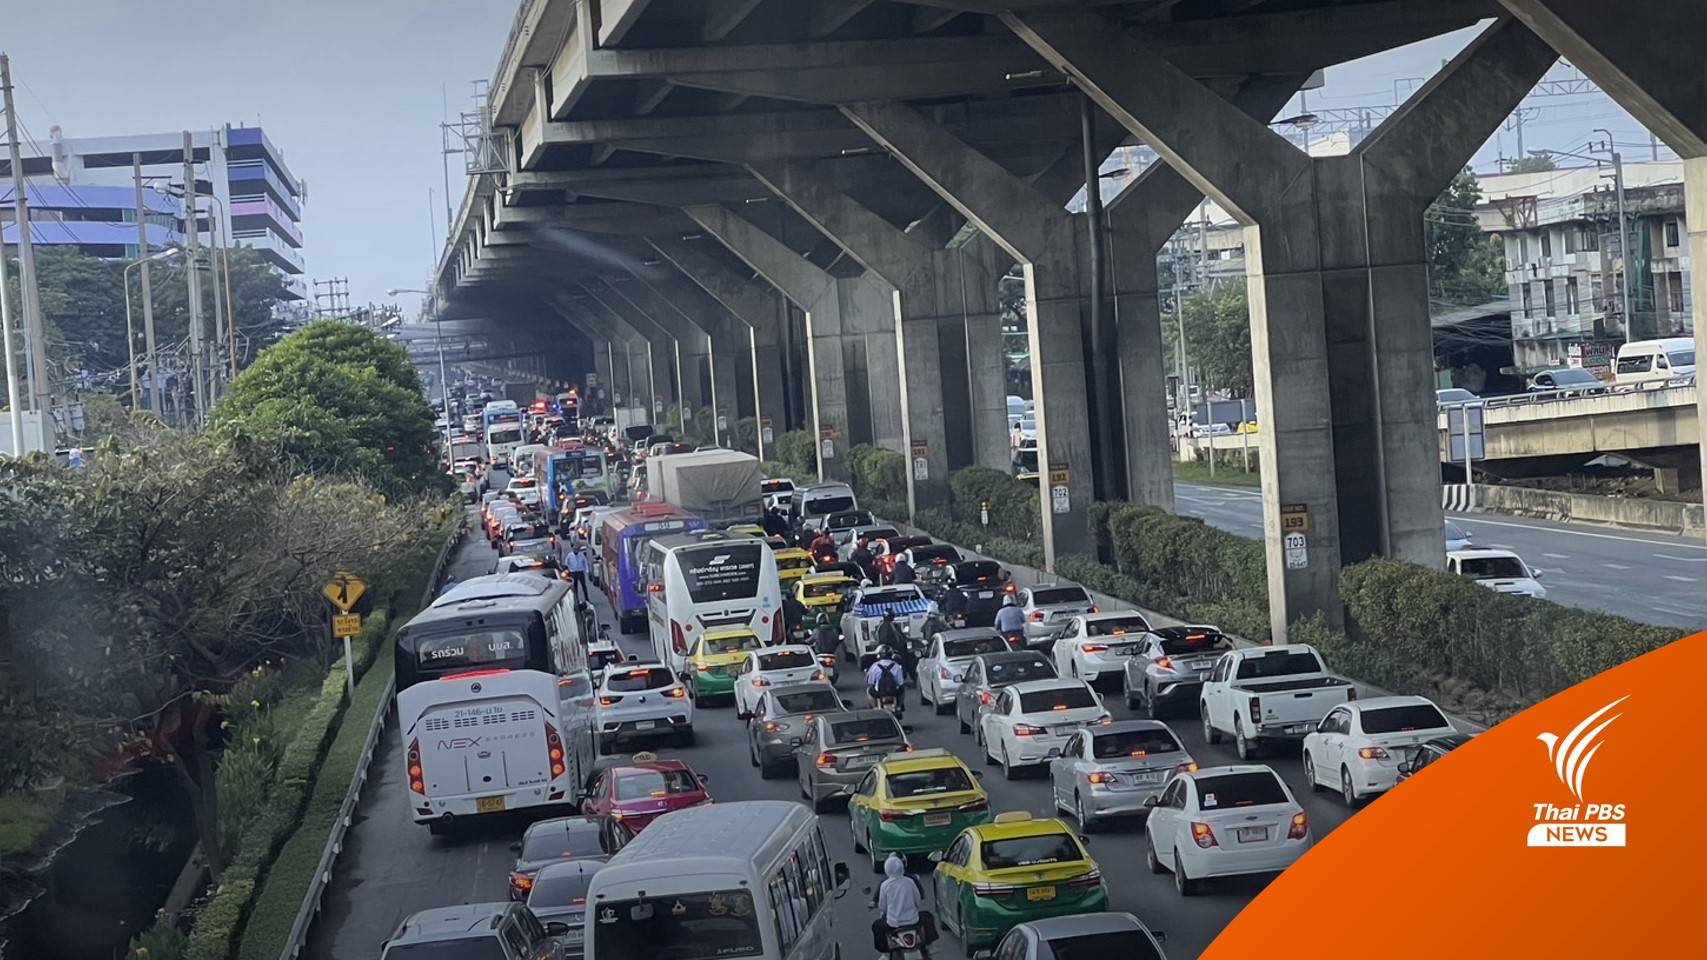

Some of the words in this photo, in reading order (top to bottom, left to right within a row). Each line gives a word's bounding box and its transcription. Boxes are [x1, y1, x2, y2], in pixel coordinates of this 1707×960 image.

[1054, 487, 1068, 497] 702
[1285, 516, 1305, 528] 193
[1287, 536, 1305, 548] 703
[437, 735, 483, 751] NEX
